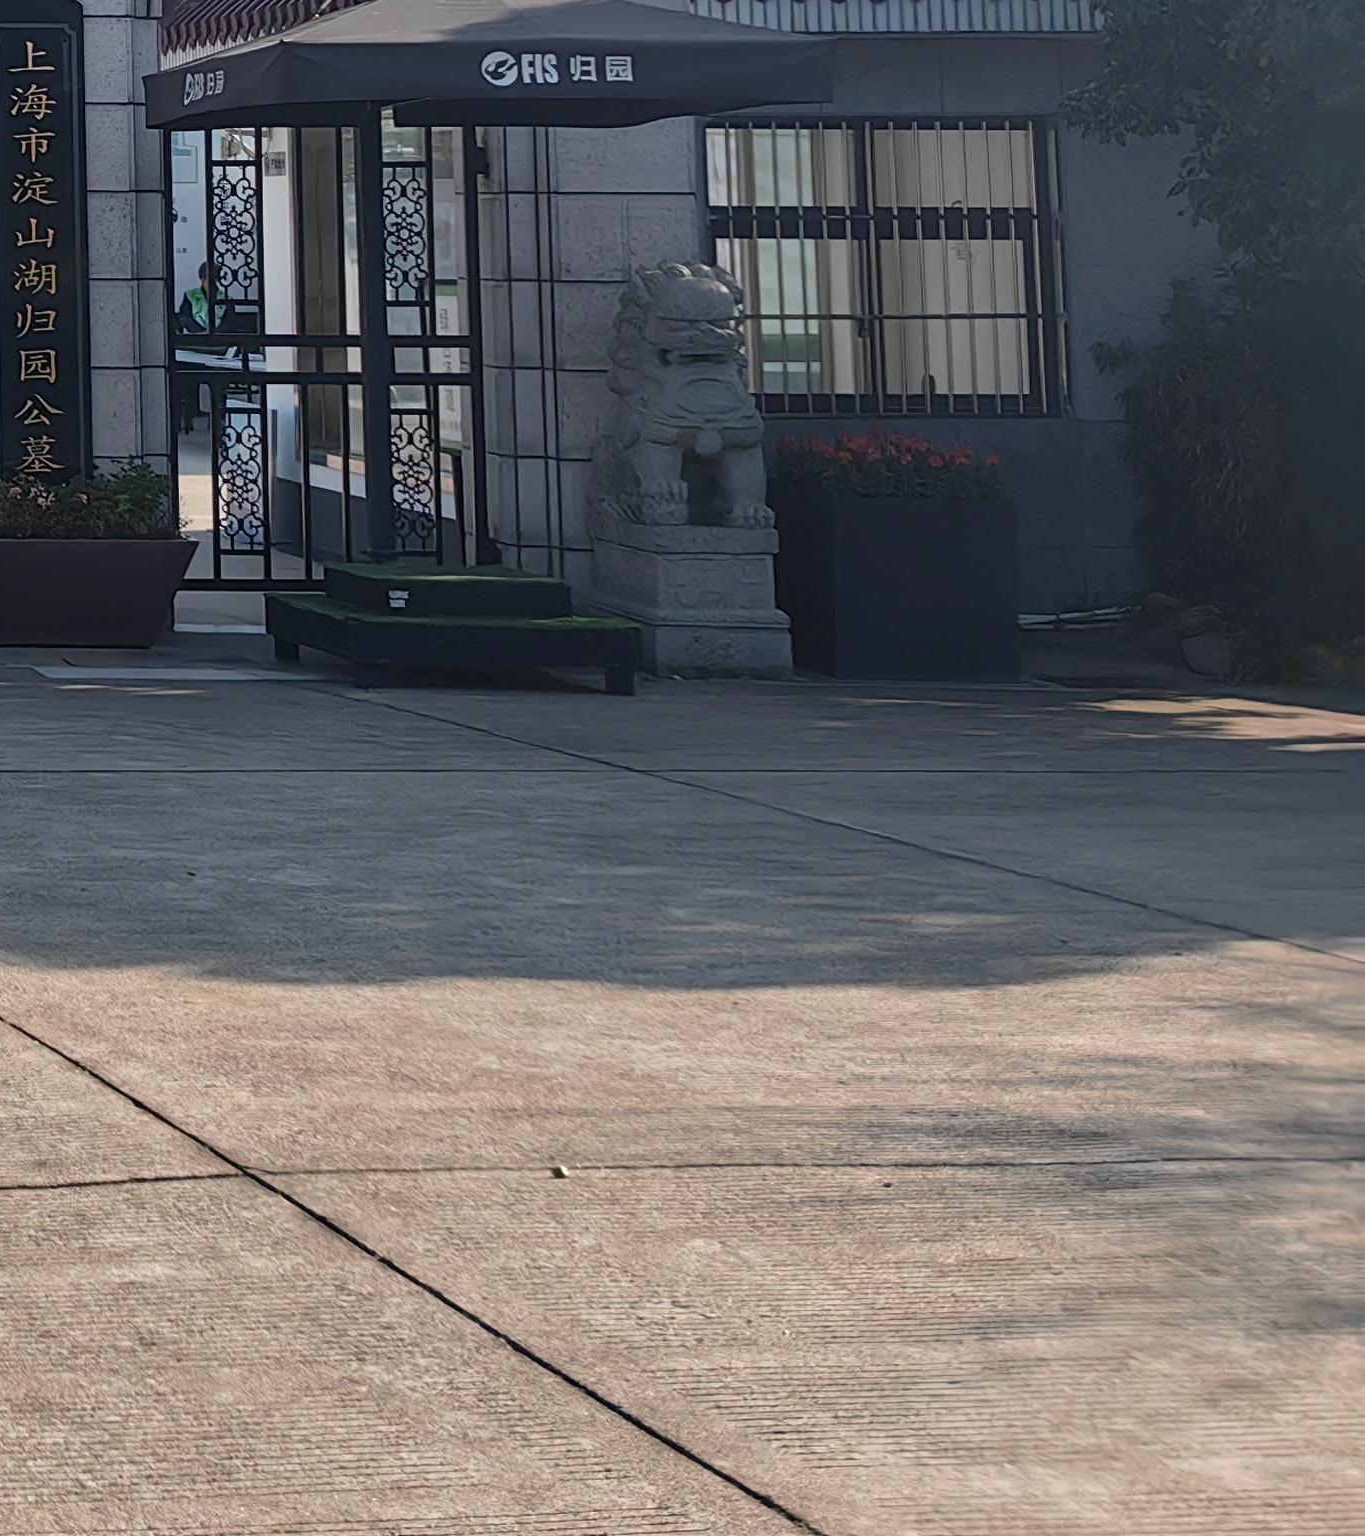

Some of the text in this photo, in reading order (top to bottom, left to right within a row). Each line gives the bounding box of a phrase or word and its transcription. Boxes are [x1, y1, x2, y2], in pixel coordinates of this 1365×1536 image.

[521, 53, 633, 84] FIS 归园
[8, 41, 66, 473] 上海市淀山湖归园公墓
